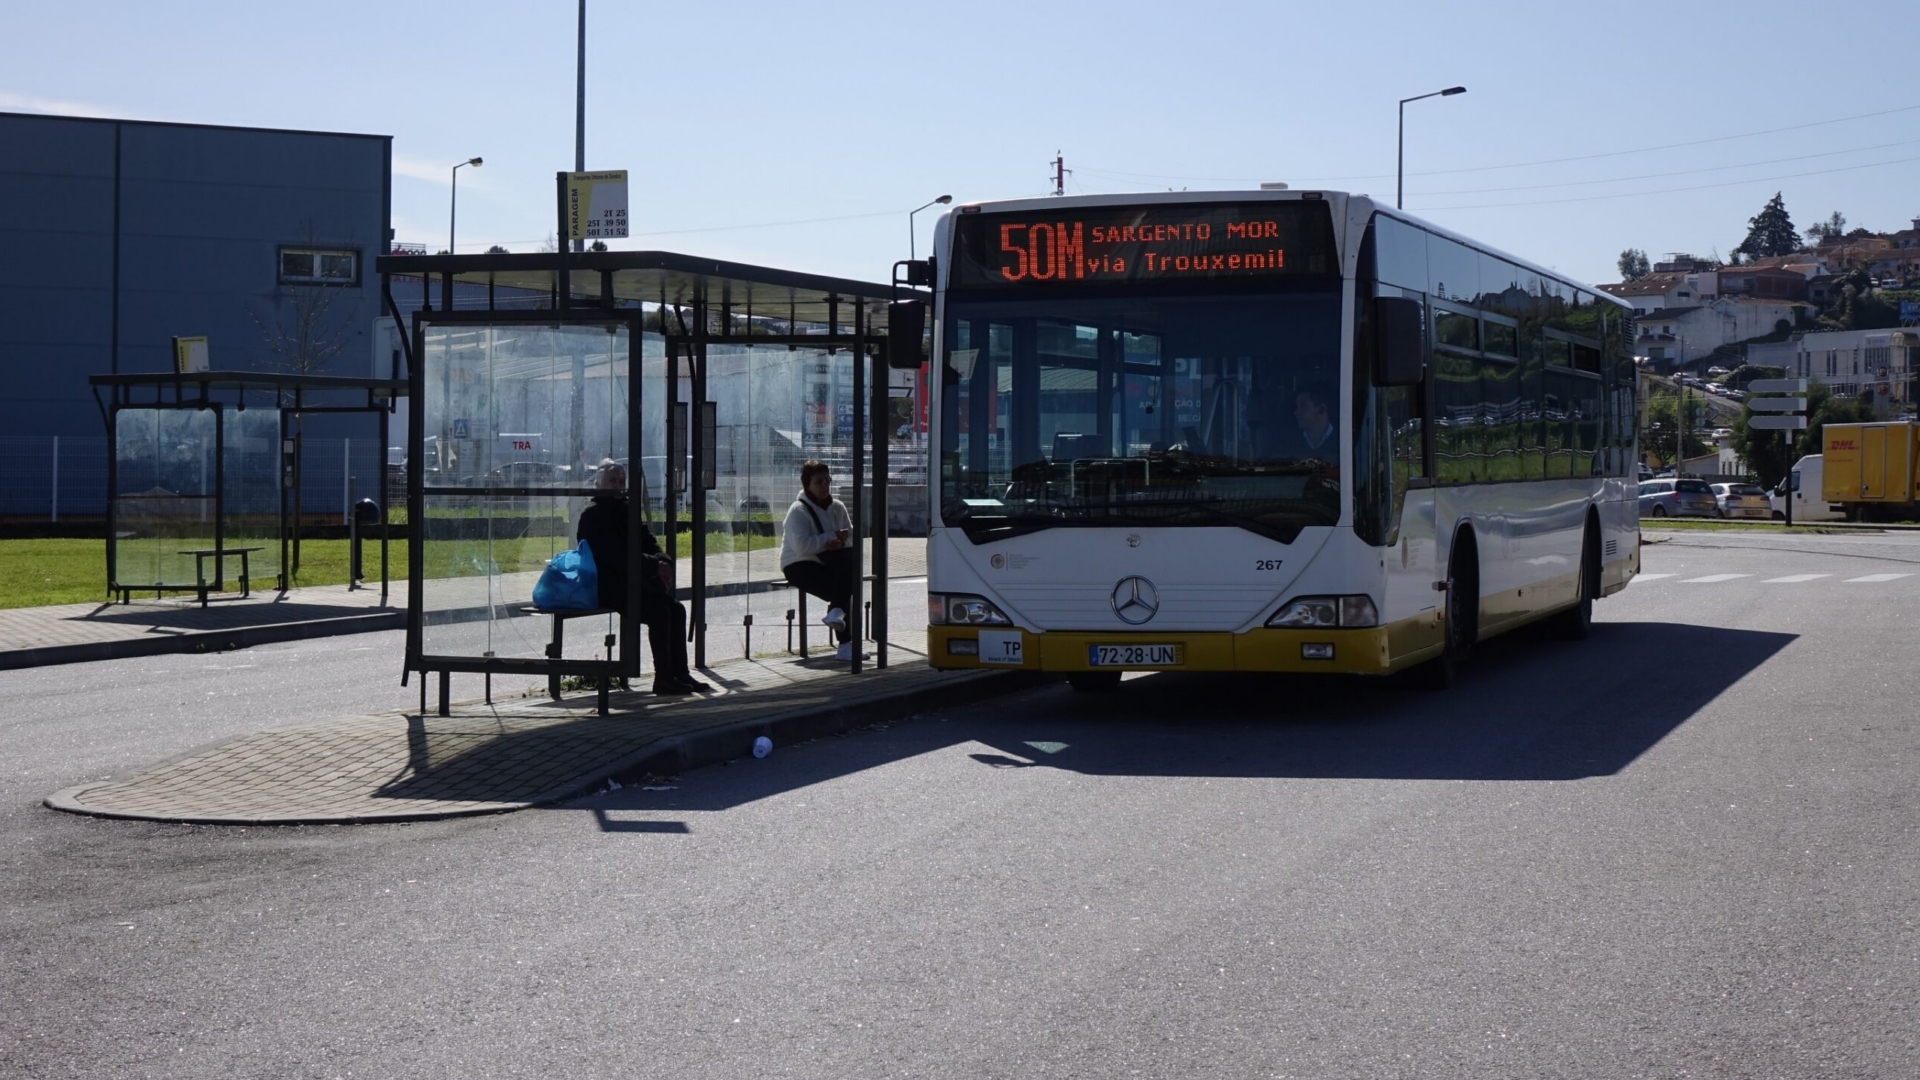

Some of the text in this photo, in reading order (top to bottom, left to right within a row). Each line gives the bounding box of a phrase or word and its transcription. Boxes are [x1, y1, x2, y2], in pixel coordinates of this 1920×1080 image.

[571, 188, 579, 236] PARAGEM
[603, 209, 626, 217] 2T 25
[587, 219, 601, 227] 25T
[603, 219, 614, 227] 39
[604, 228, 614, 236] 51
[1091, 222, 1211, 243] SARGENTO
[1227, 221, 1280, 239] MOR
[1087, 248, 1284, 273] via Trouxemil
[513, 441, 531, 450] TRA
[1830, 440, 1855, 451] DHL
[1256, 560, 1283, 571] 267
[1003, 641, 1021, 655] TP
